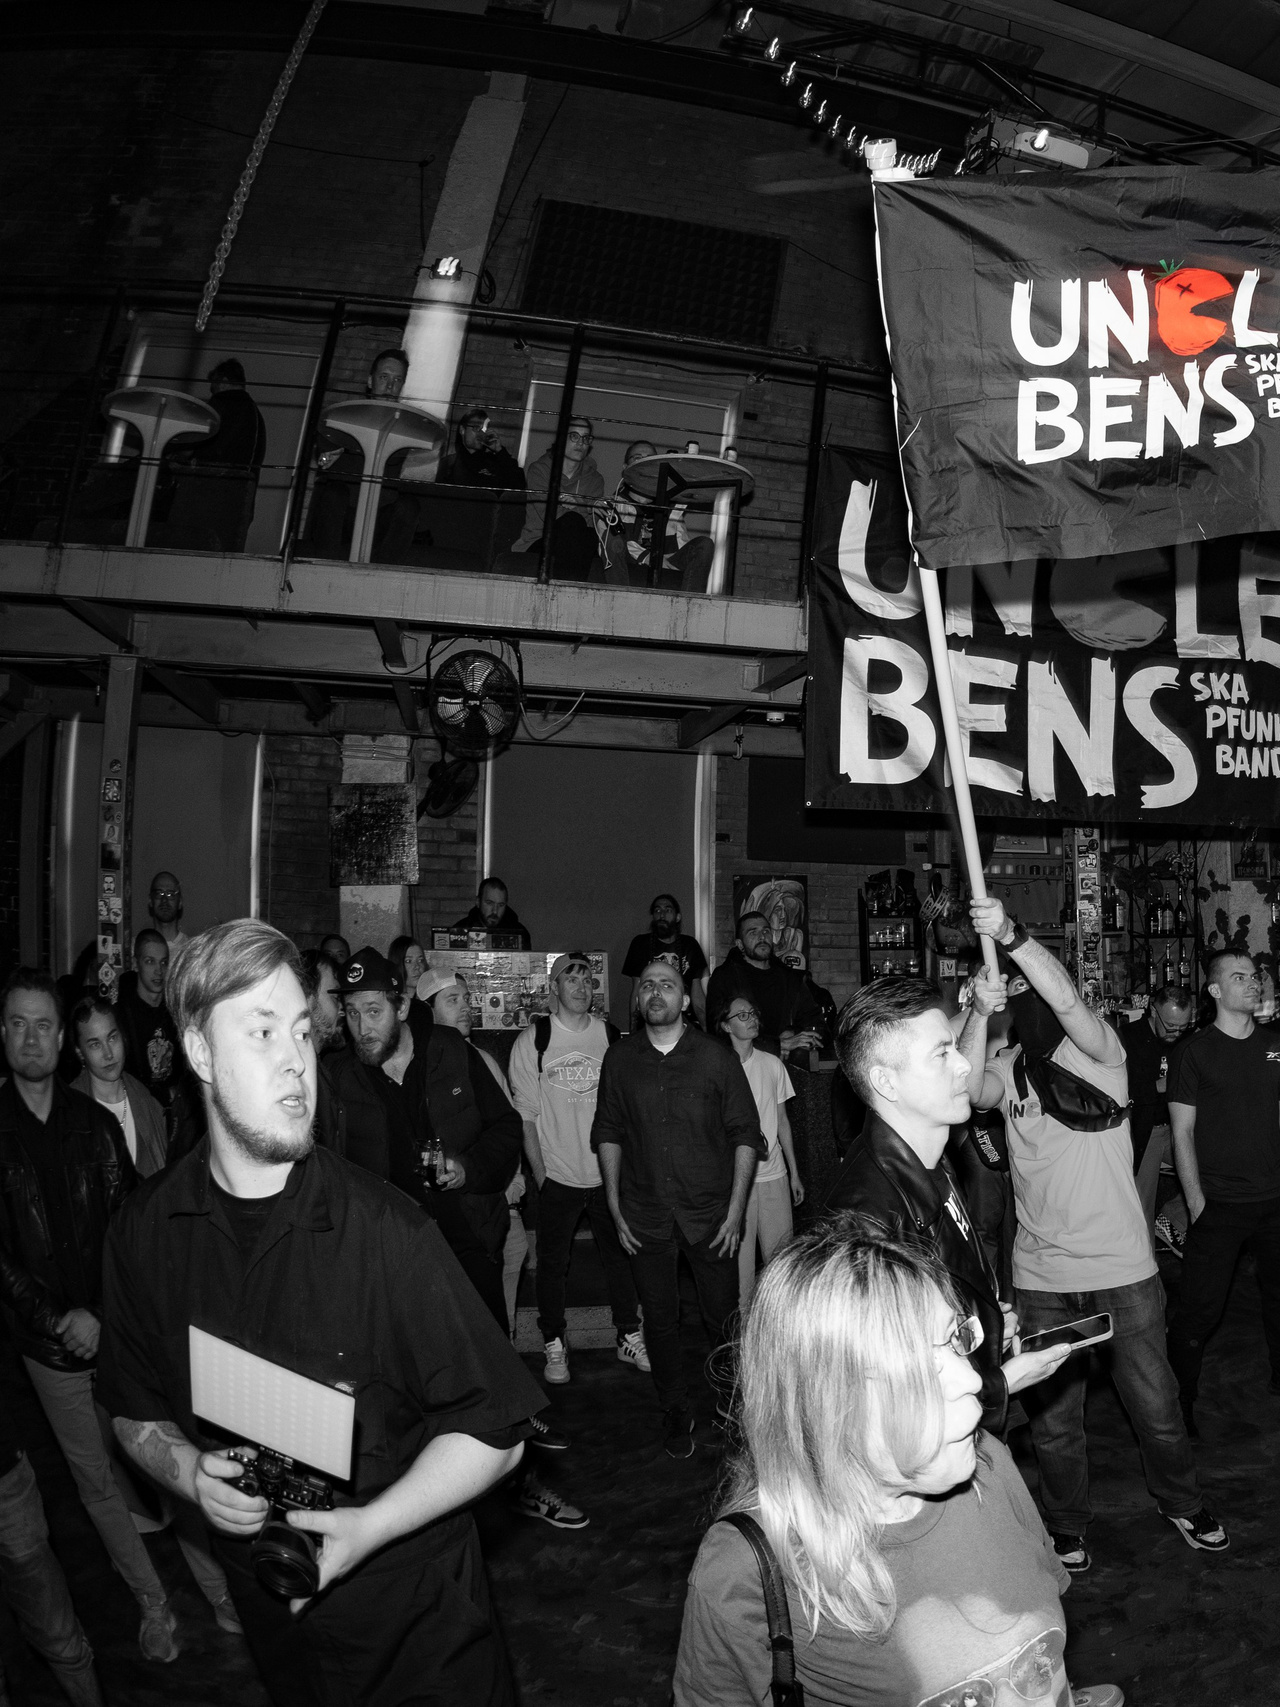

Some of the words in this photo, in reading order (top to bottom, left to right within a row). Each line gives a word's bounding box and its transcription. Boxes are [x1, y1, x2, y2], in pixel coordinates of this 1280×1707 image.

[1017, 354, 1256, 465] BENS
[839, 634, 1199, 809] BENS
[1189, 672, 1250, 704] SKA
